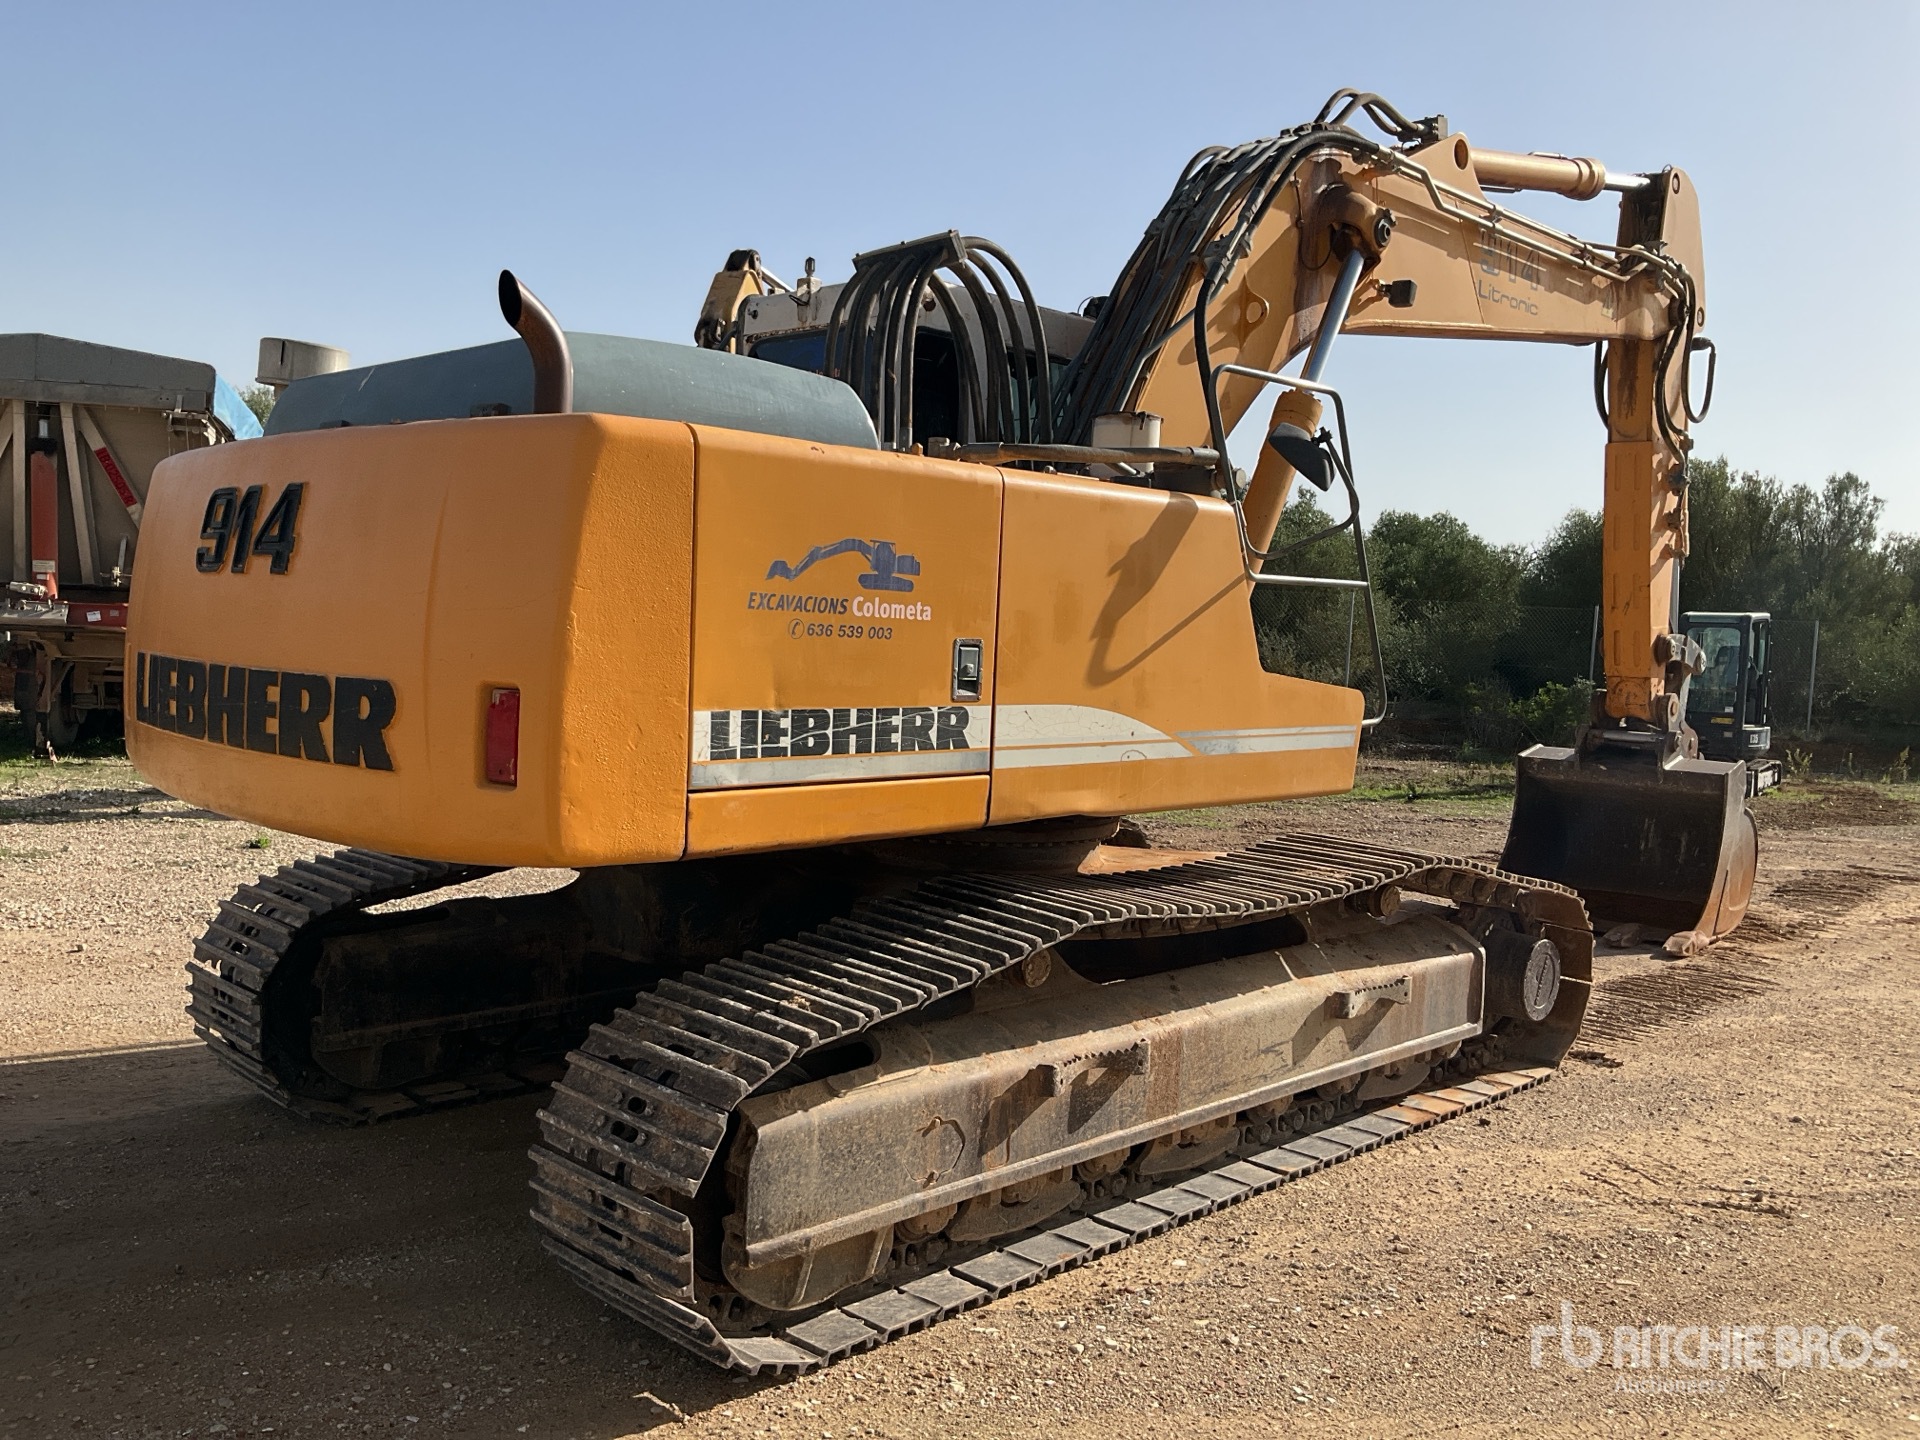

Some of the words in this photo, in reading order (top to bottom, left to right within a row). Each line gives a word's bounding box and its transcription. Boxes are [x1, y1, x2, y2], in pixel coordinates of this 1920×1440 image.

[1478, 279, 1539, 316] Litronic
[196, 482, 304, 574] 914
[747, 591, 849, 615] EXCAVACIONS
[852, 596, 932, 621] Colometa
[807, 623, 833, 637] 636
[838, 624, 863, 639] 539
[868, 626, 893, 640] 003
[136, 652, 396, 771] LIEBHERR
[710, 706, 970, 761] LIEBHERR
